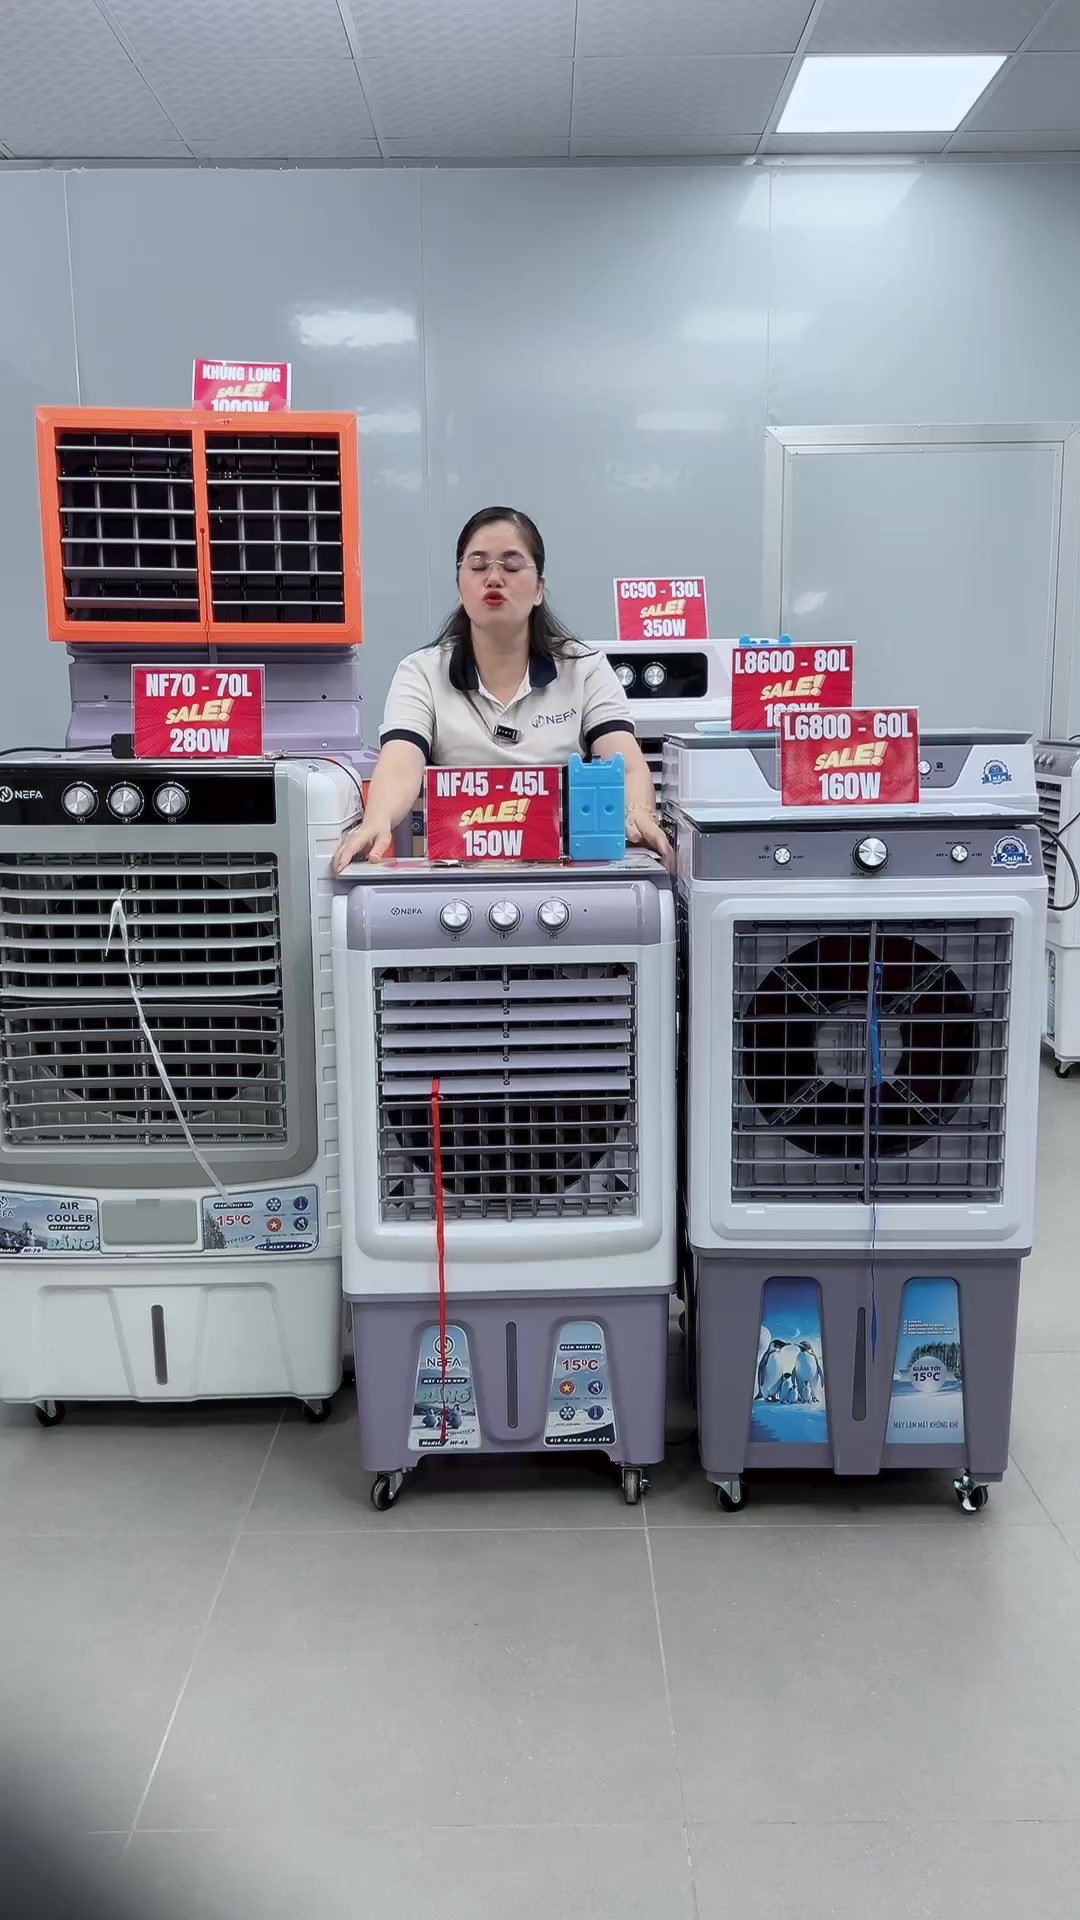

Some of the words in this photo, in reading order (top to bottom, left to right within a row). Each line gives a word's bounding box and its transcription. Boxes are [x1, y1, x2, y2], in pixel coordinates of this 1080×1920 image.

[203, 361, 245, 380] KHỦNG
[248, 367, 281, 382] LONG
[216, 382, 268, 399] SALE!
[620, 581, 656, 599] CC90
[669, 580, 702, 598] 130L
[640, 599, 686, 618] SALE!
[643, 618, 686, 637] 350W
[735, 650, 795, 674] L8600
[814, 649, 850, 672] 80L
[146, 673, 196, 697] NF70
[216, 673, 252, 697] 70L
[760, 674, 826, 700] SALE!
[165, 698, 235, 725] SALE!
[545, 707, 577, 725] NEFA
[784, 713, 851, 740] L6800
[873, 712, 913, 738] 60L
[170, 728, 230, 752] 280W
[814, 741, 889, 771] SALE!
[14, 790, 43, 799] NEFA
[437, 772, 489, 797] NF45
[510, 771, 549, 796] 45L
[818, 772, 881, 800] 160W
[459, 798, 531, 827] SALE!
[463, 830, 523, 857] 150W
[1000, 853, 1008, 862] 2
[59, 1202, 79, 1210] AIR
[46, 1214, 93, 1223] COOLER
